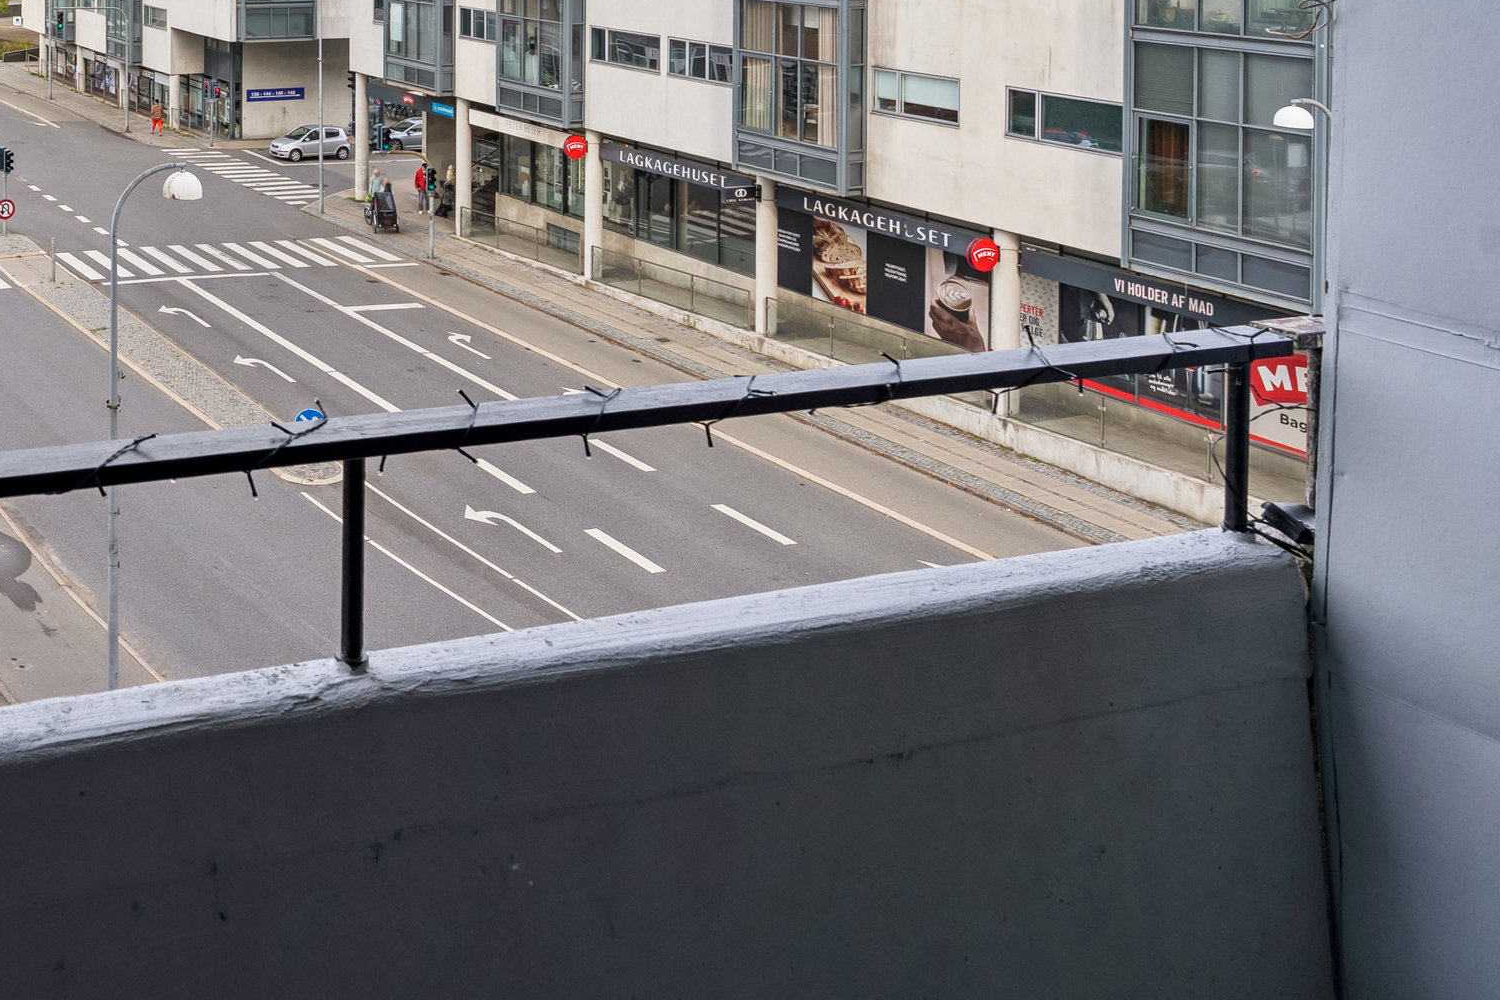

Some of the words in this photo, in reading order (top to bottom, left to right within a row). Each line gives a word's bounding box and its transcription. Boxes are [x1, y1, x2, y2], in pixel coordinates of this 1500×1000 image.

[505, 119, 522, 132] PETER
[619, 150, 727, 188] LAGKAGEHUSET
[977, 251, 996, 260] MENY
[1114, 278, 1125, 293] VI
[1127, 282, 1168, 305] HOLDER
[1171, 292, 1185, 309] AF
[1188, 297, 1214, 317] MAD
